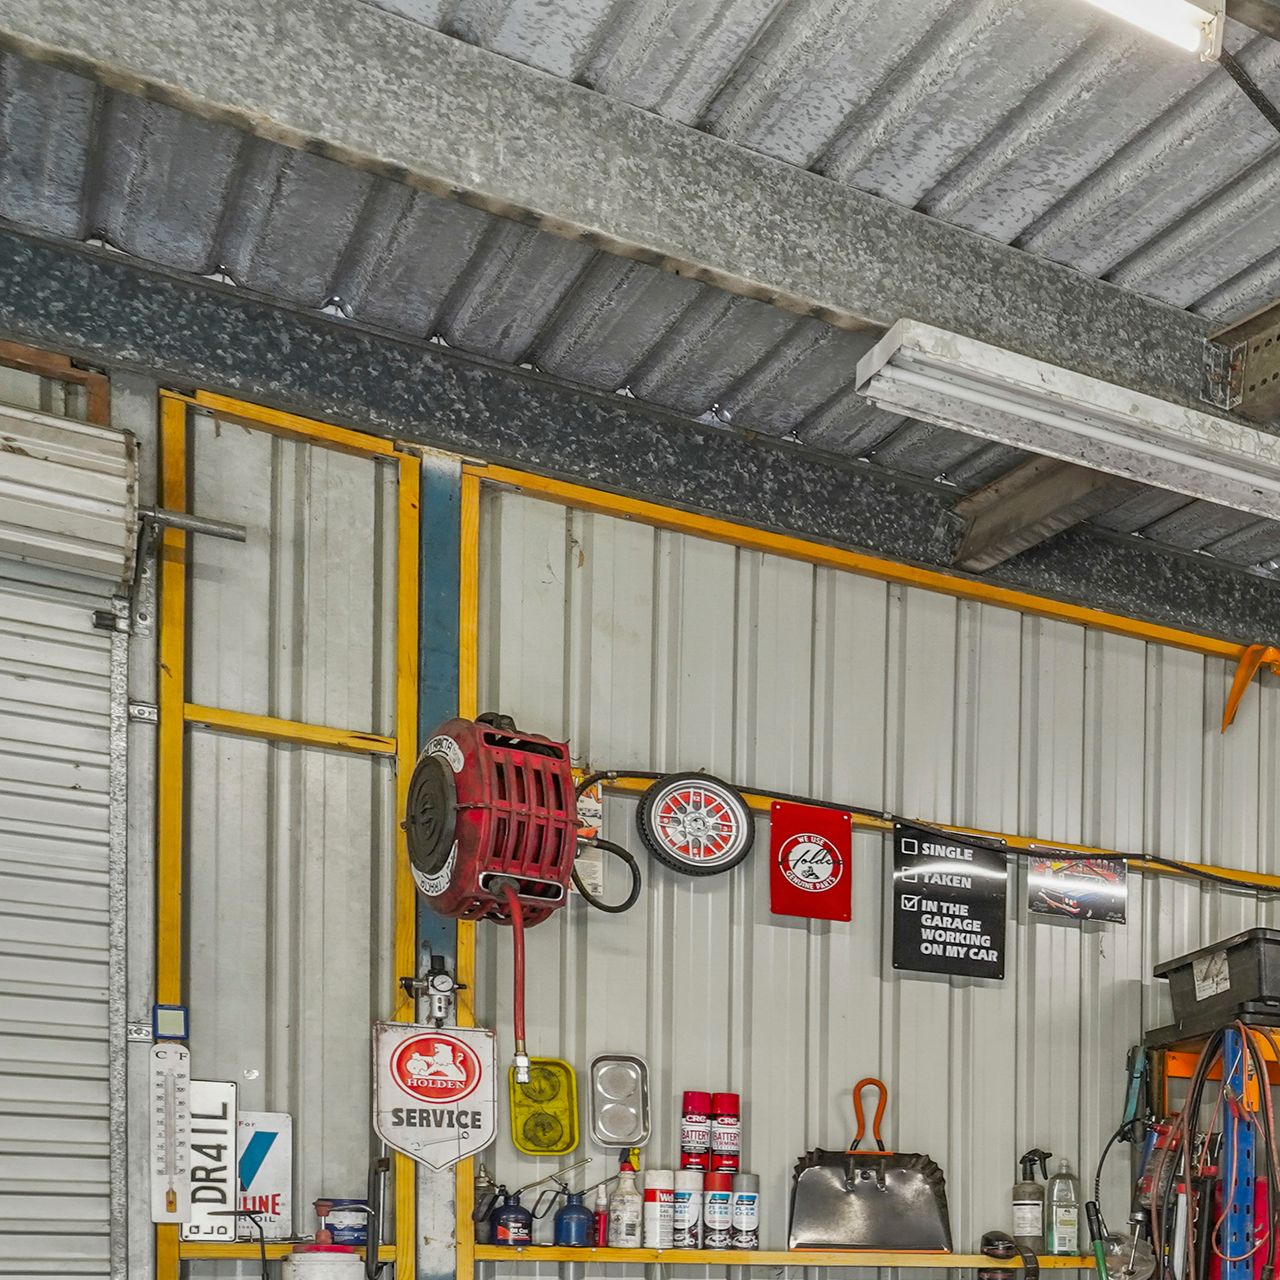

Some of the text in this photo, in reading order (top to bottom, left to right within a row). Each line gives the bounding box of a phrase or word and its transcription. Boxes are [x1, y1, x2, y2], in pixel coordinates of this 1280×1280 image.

[811, 837, 826, 847] USE
[922, 843, 974, 861] SINGLE
[786, 870, 836, 890] GENUINE PARTS
[922, 872, 972, 889] TAKEN
[922, 899, 969, 917] IN THE
[921, 914, 982, 932] GARAGE
[921, 928, 991, 948] WORKING
[920, 943, 998, 962] ON MY CAR
[156, 1051, 167, 1059] C
[407, 1079, 466, 1089] HOLDEN
[391, 1108, 482, 1129] SERVICE
[239, 1193, 281, 1216] LINE
